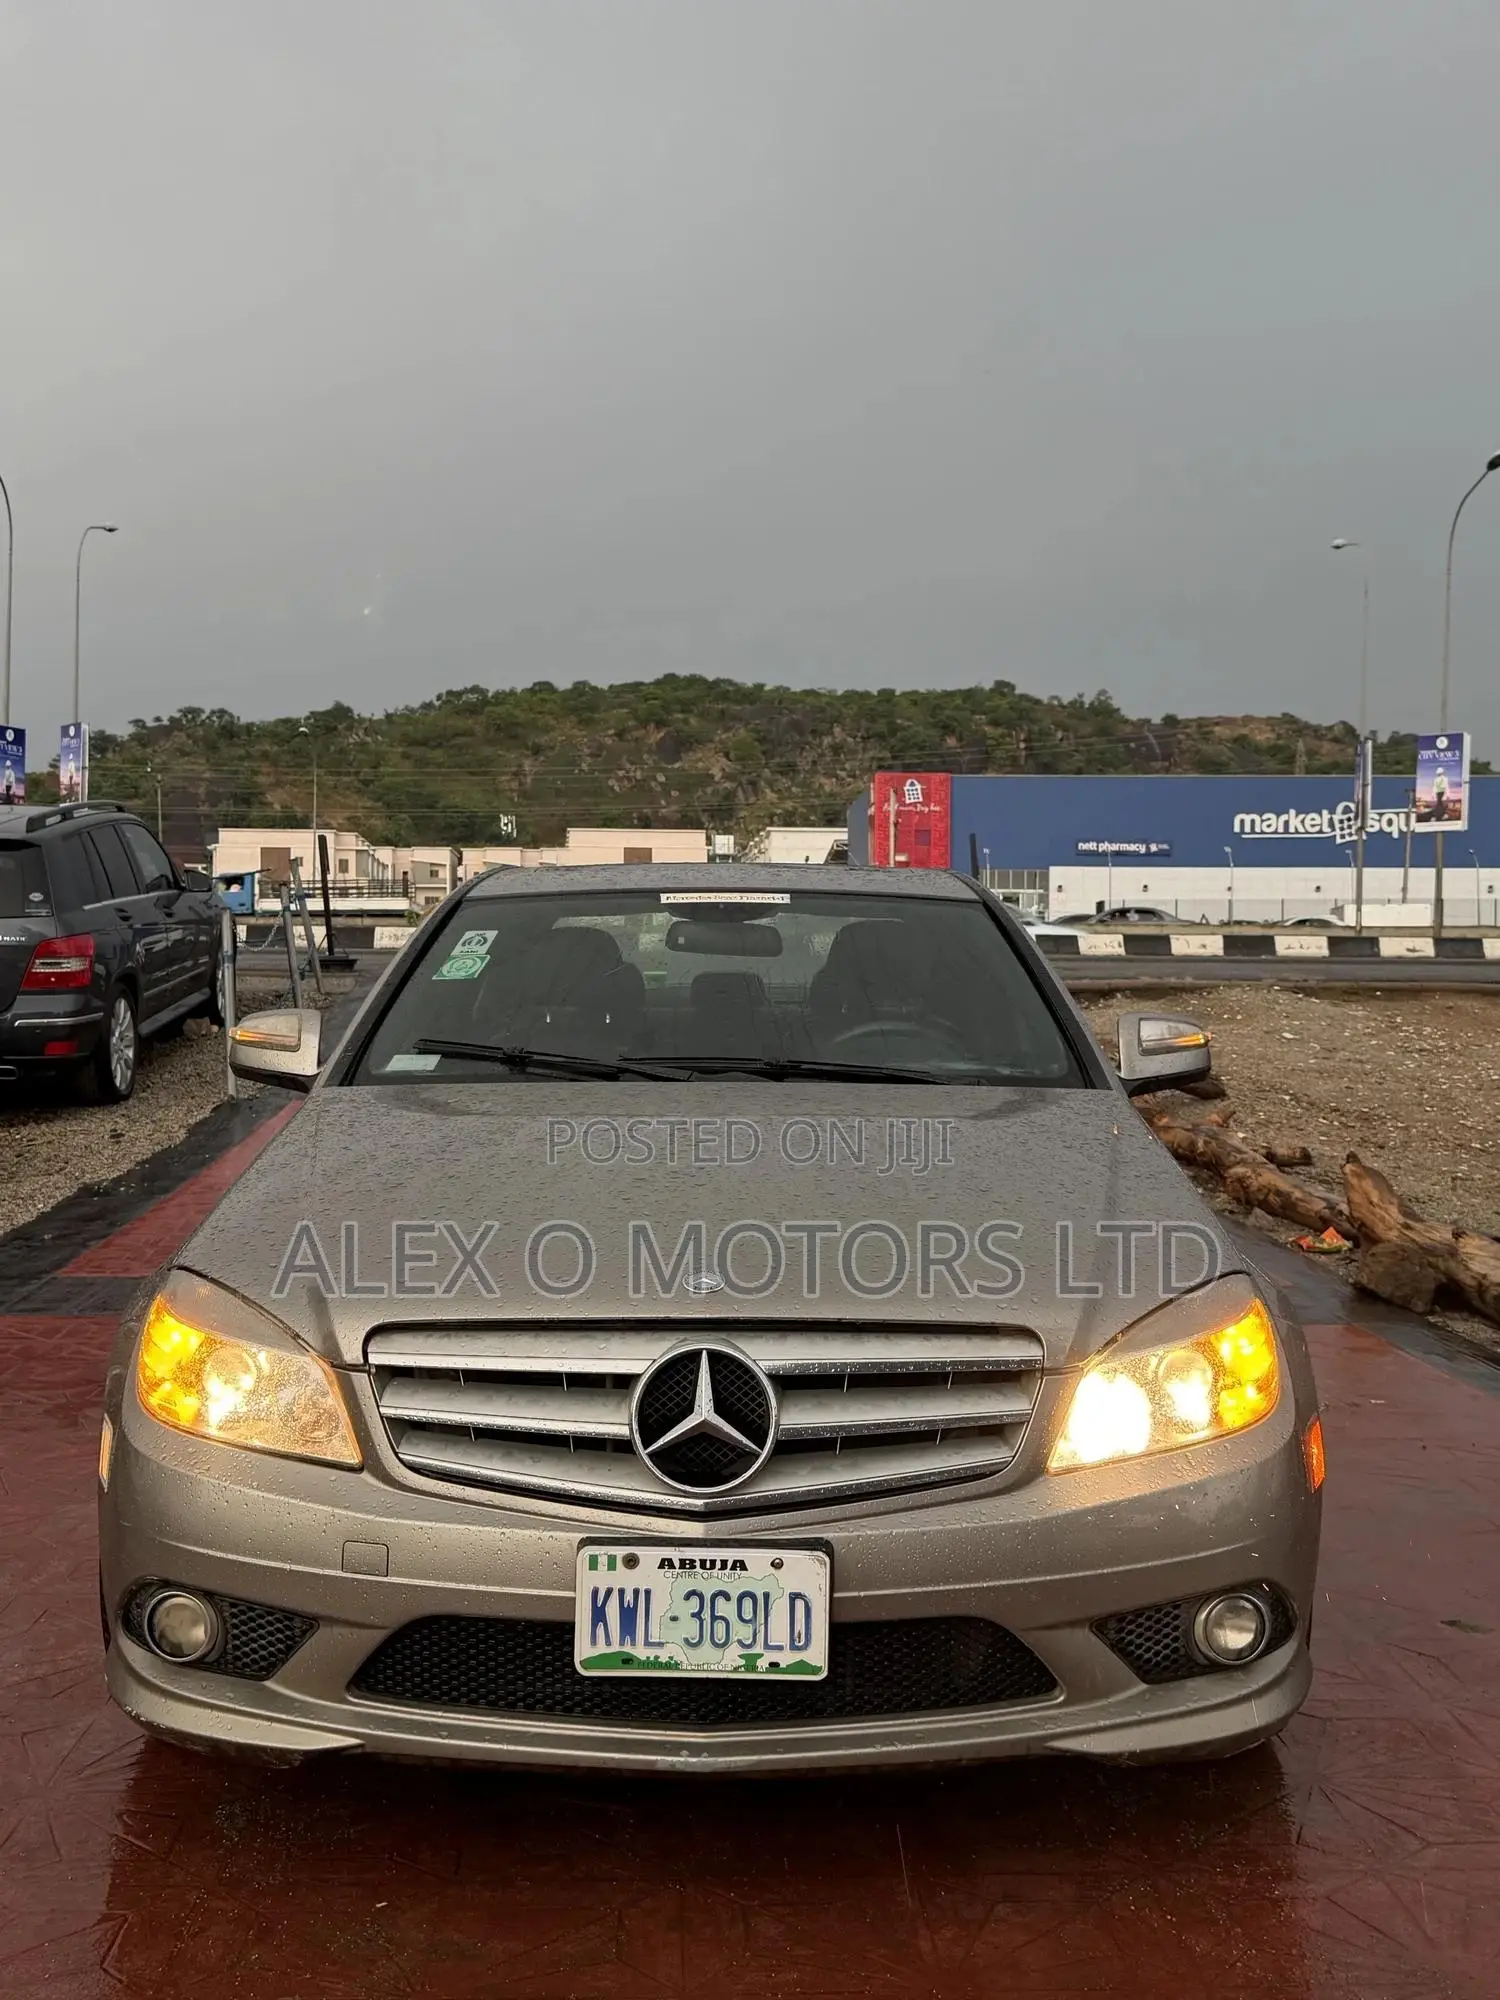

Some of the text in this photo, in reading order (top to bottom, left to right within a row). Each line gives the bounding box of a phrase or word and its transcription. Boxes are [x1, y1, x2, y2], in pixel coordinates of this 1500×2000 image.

[1233, 809, 1332, 833] market
[1078, 841, 1097, 851] nett
[1098, 841, 1146, 854] pharmacy
[657, 1557, 749, 1571] ABUJA
[663, 1570, 743, 1581] CENTRE OF UNITY
